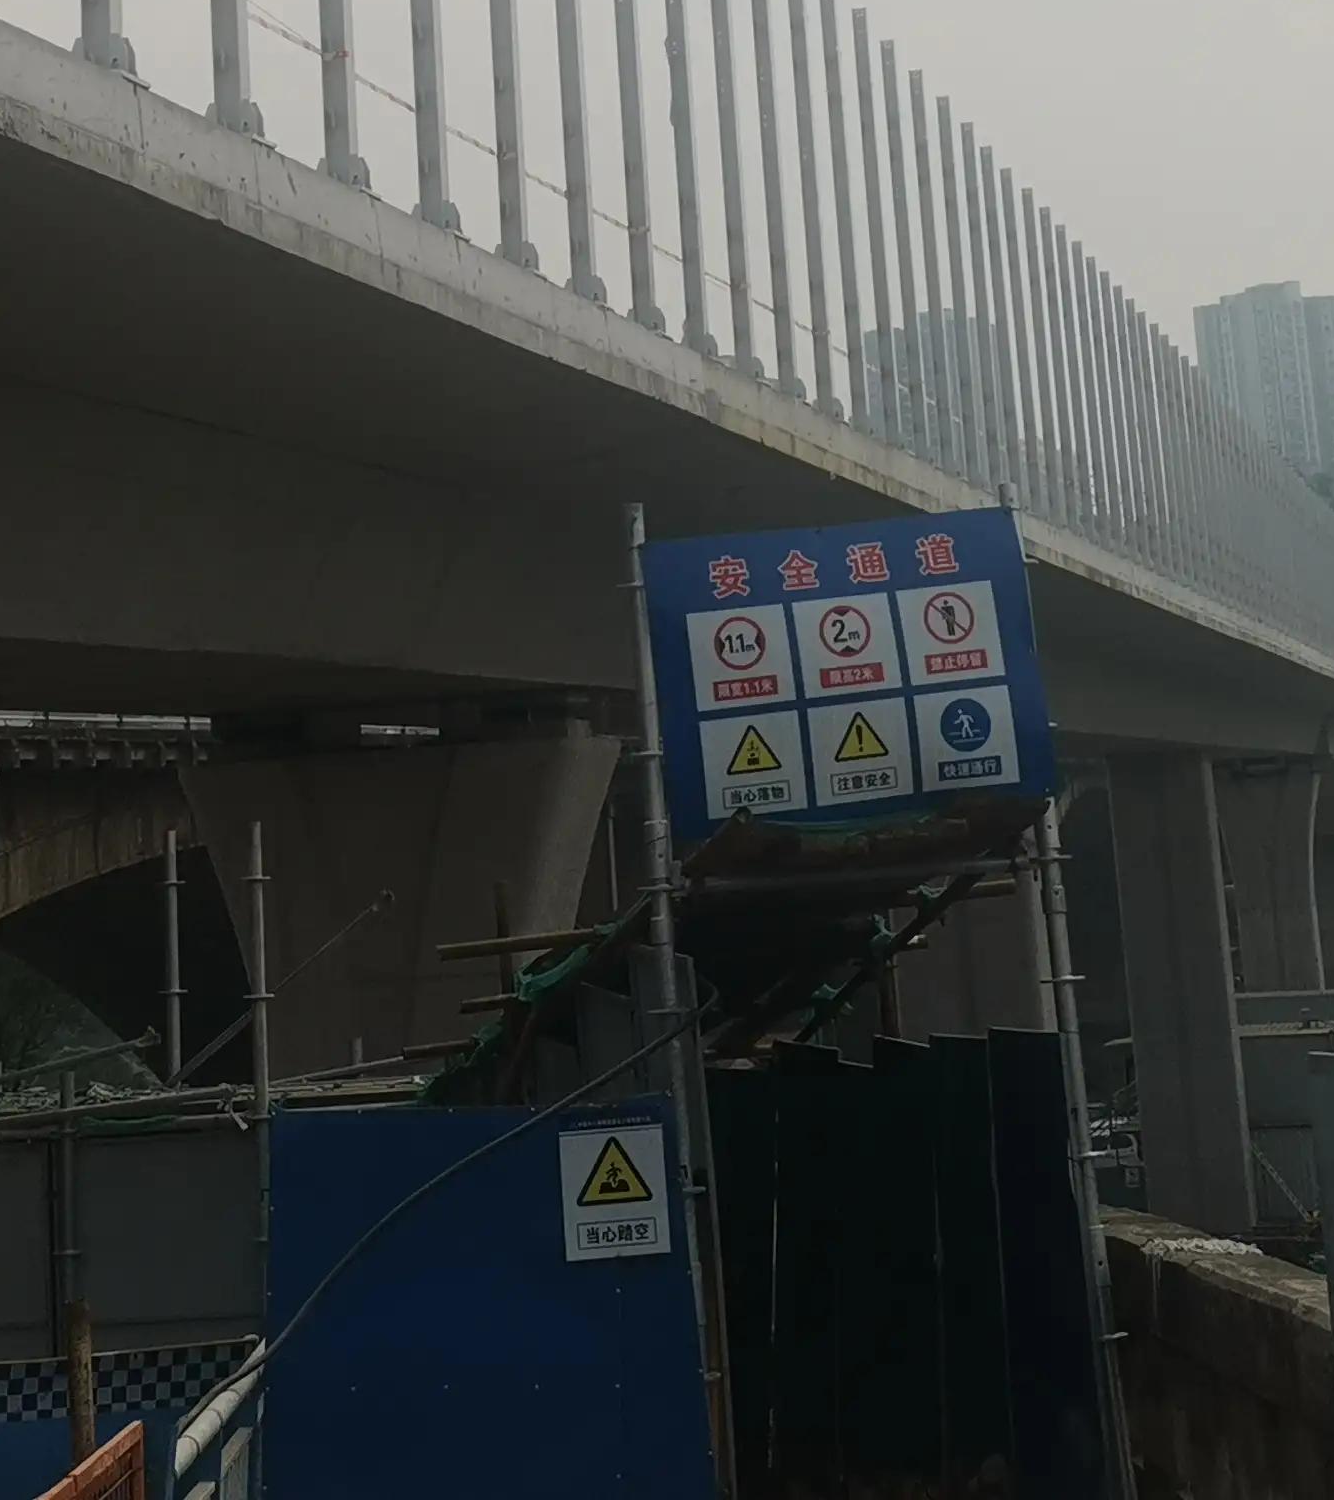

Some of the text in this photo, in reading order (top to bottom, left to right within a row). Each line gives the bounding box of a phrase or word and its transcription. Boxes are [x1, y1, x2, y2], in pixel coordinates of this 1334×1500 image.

[709, 534, 959, 599] 安全通道
[831, 619, 861, 644] 2m
[837, 773, 892, 791] 注意安全
[731, 786, 784, 805] 当心落物
[586, 1223, 650, 1244] 当心踏空
